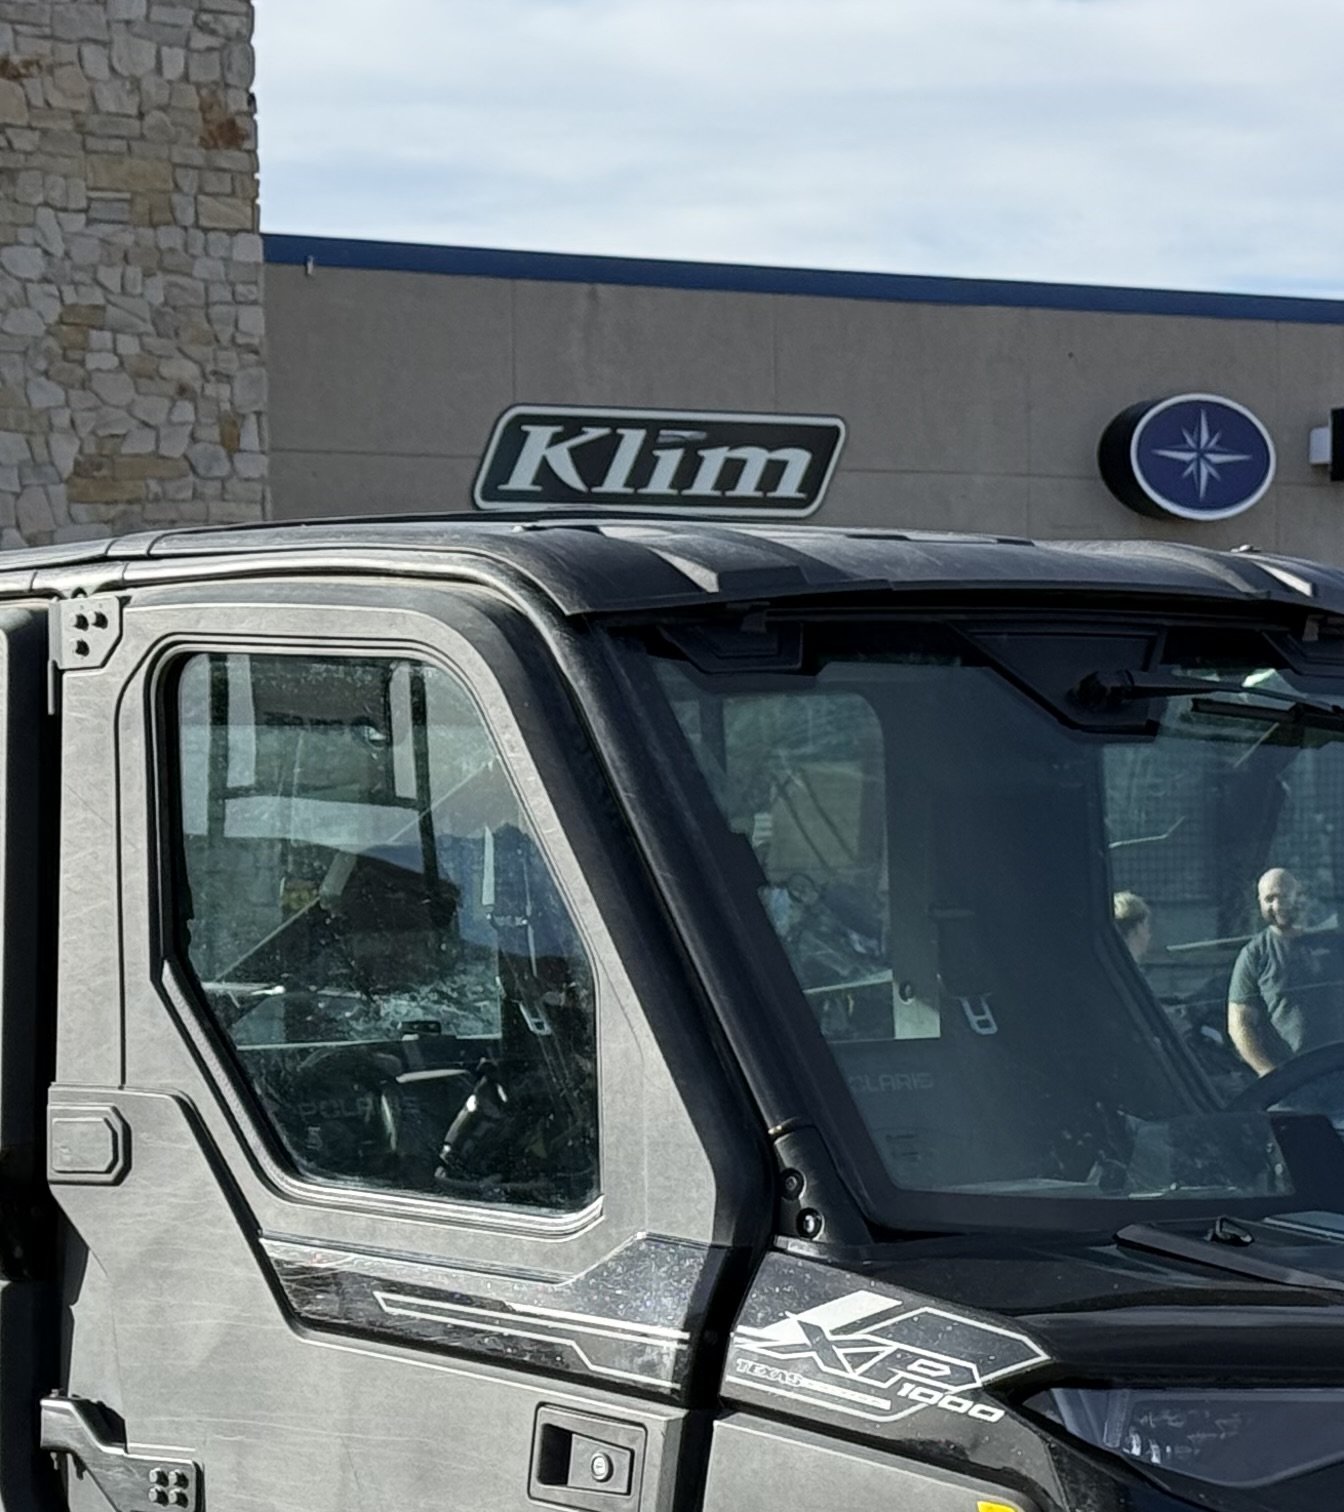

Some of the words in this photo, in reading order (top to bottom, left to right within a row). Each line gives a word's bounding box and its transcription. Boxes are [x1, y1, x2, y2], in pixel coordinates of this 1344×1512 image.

[497, 424, 815, 499] Klim
[736, 1357, 805, 1387] TEXAS
[897, 1382, 1006, 1423] 1000
